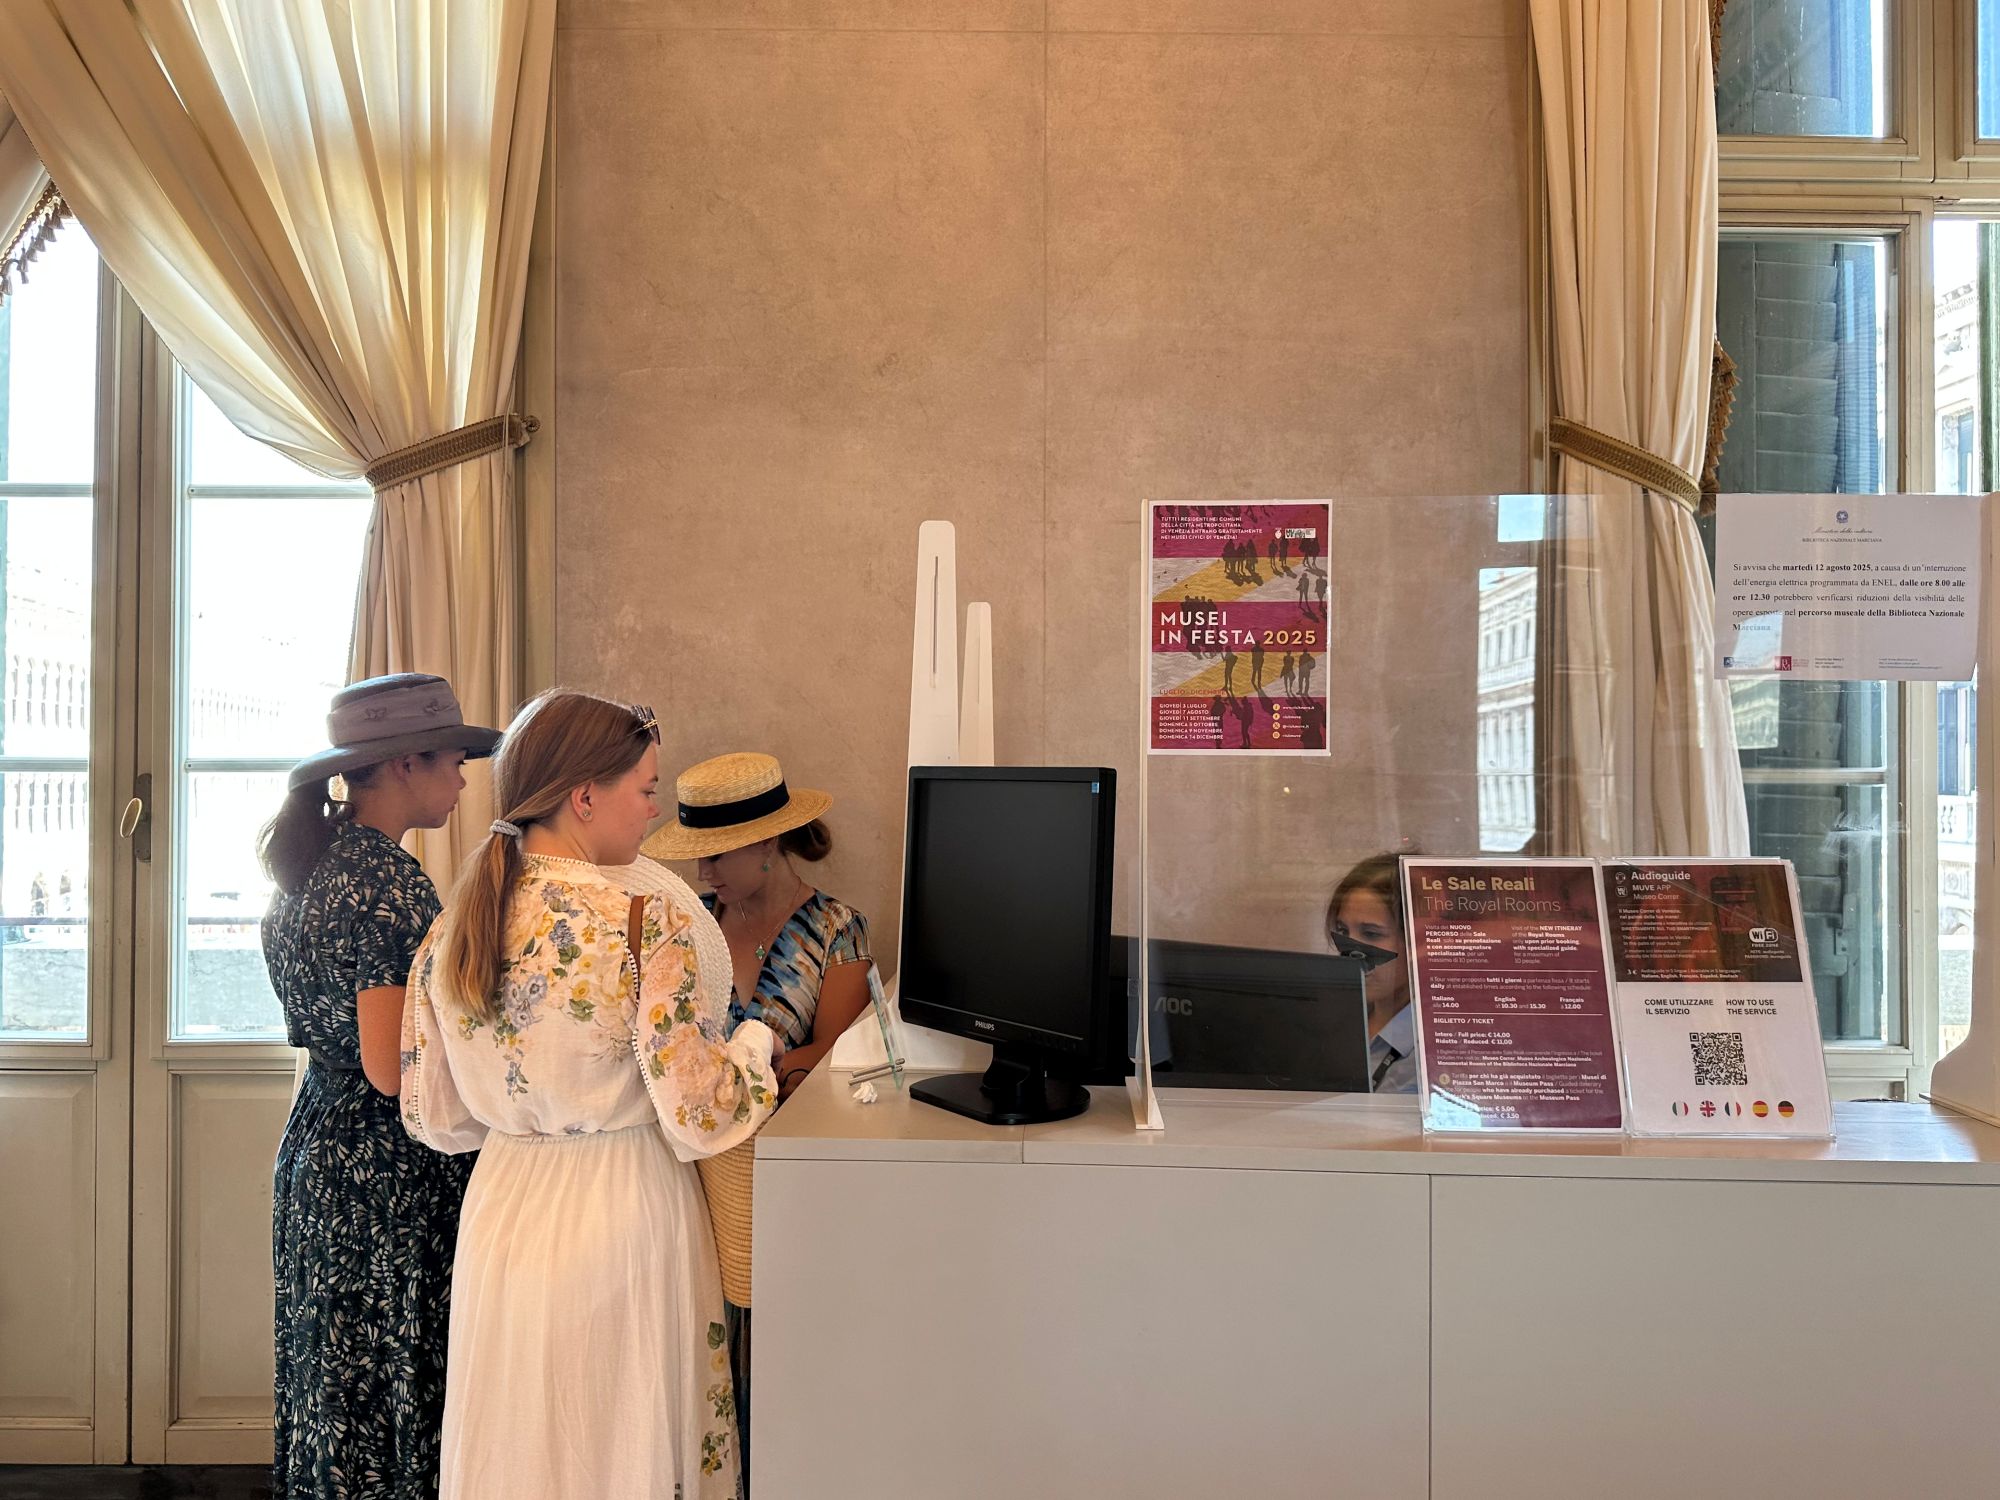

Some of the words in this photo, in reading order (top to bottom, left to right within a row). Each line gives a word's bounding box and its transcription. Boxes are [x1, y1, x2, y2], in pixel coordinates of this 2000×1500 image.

[1852, 564, 1873, 572] 2025,
[1733, 579, 1777, 587] dell'energia
[1872, 579, 1897, 587] ENEL,
[1773, 594, 1813, 602] potrebbero
[1893, 594, 1911, 602] della
[1914, 594, 1945, 602] visibilità
[1160, 611, 1227, 626] MUSEI
[1867, 609, 1886, 617] della
[1889, 609, 1927, 617] Biblioteca
[1160, 630, 1181, 644] IN
[1191, 630, 1256, 644] FESTA
[1263, 630, 1316, 644] 2025
[1631, 871, 1691, 882] Audioguide
[1421, 877, 1443, 891] Le
[1447, 877, 1487, 891] Sale
[1490, 877, 1535, 891] Reali
[1423, 897, 1454, 911] The
[1458, 897, 1500, 914] Royal
[1505, 897, 1561, 912] Rooms
[1153, 996, 1193, 1016] AOC
[975, 1019, 995, 1031] PHILIPS
